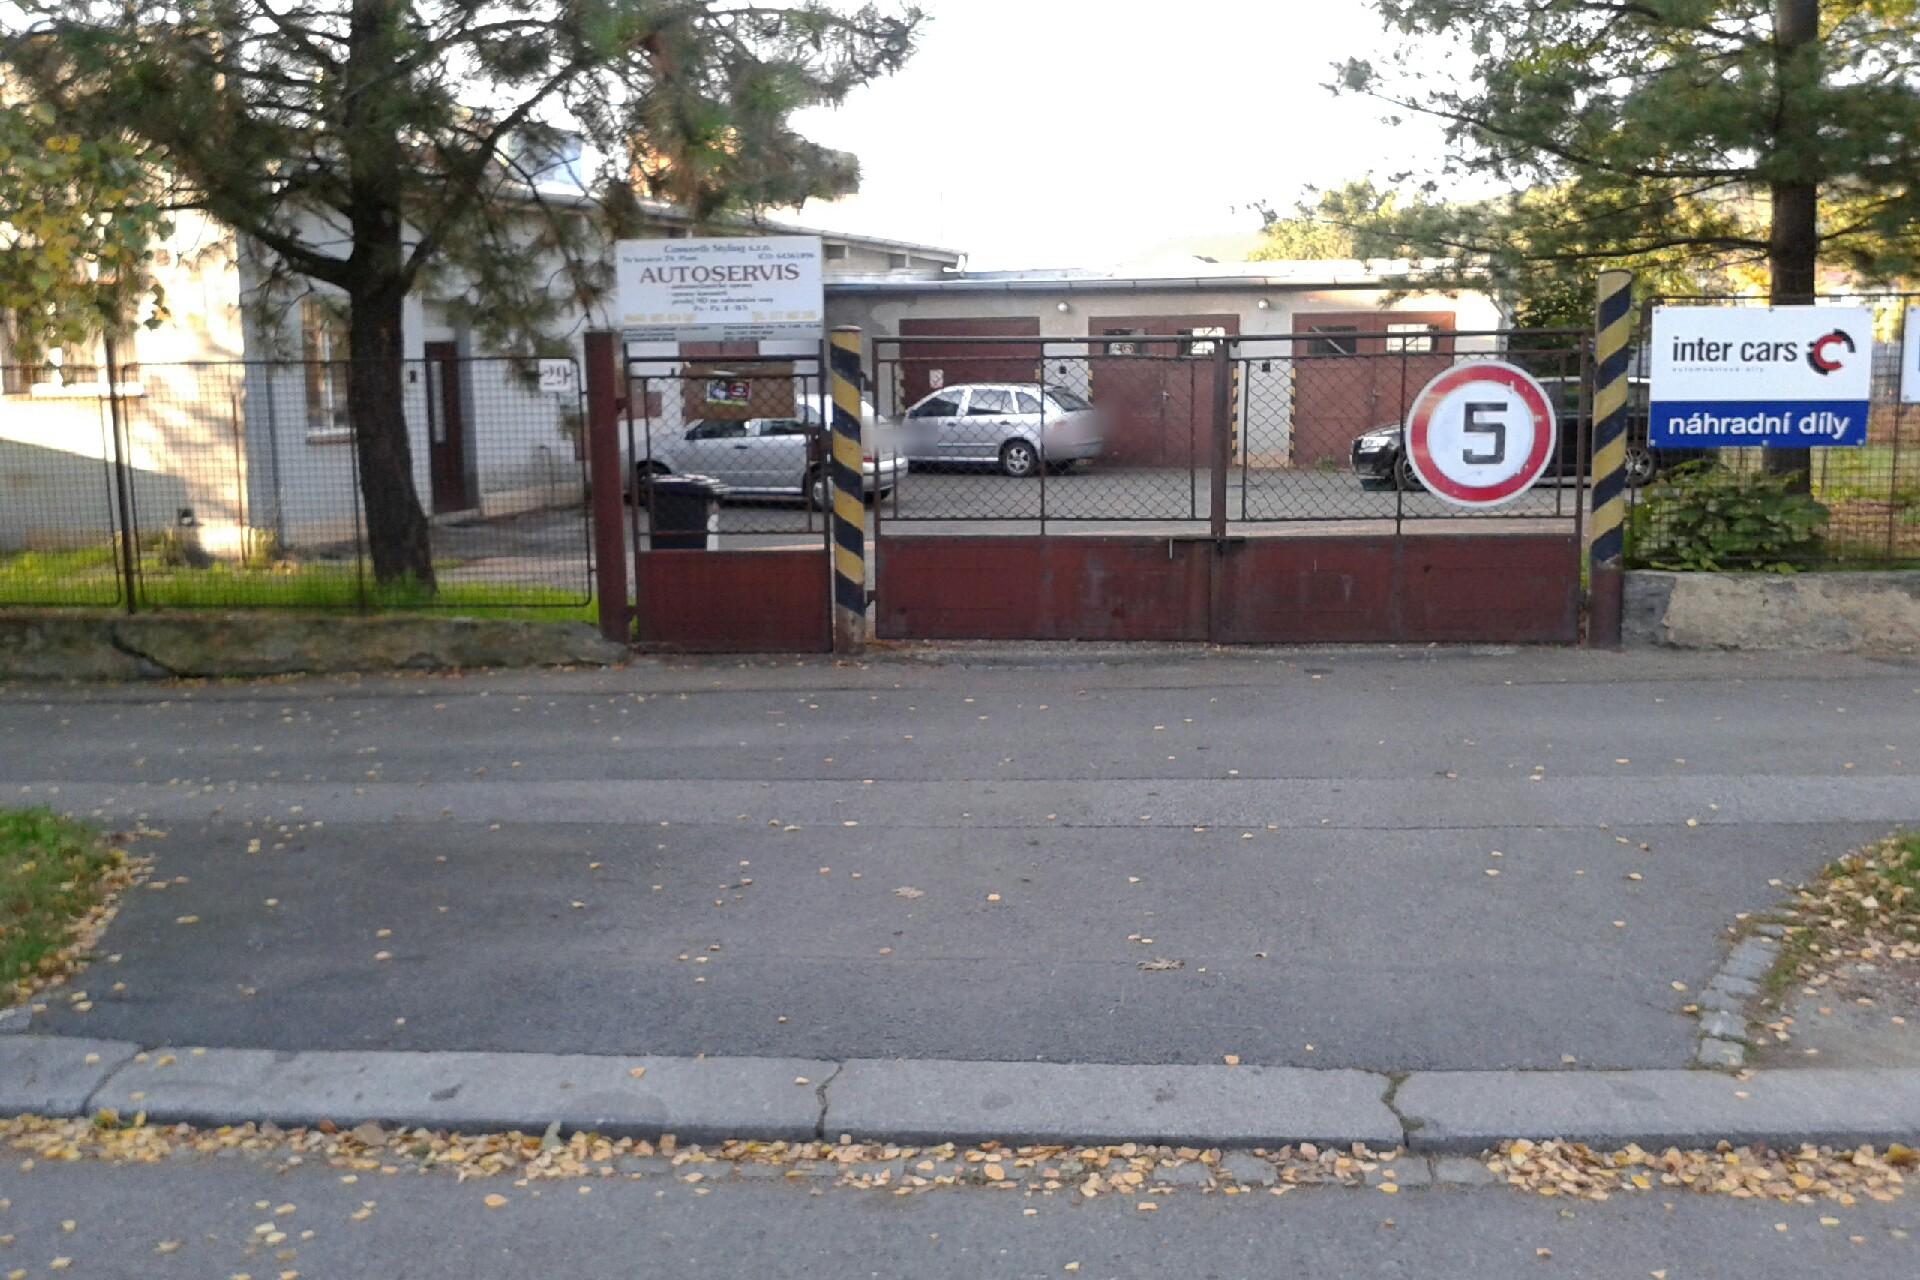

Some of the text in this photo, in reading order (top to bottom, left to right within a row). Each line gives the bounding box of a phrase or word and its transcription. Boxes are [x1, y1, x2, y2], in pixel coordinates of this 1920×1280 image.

[640, 263, 800, 284] AUTOSERVIS
[1672, 336, 1798, 362] inter cars
[542, 364, 568, 385] 29
[1462, 402, 1508, 464] 5
[1669, 412, 1848, 440] náhradní díly
